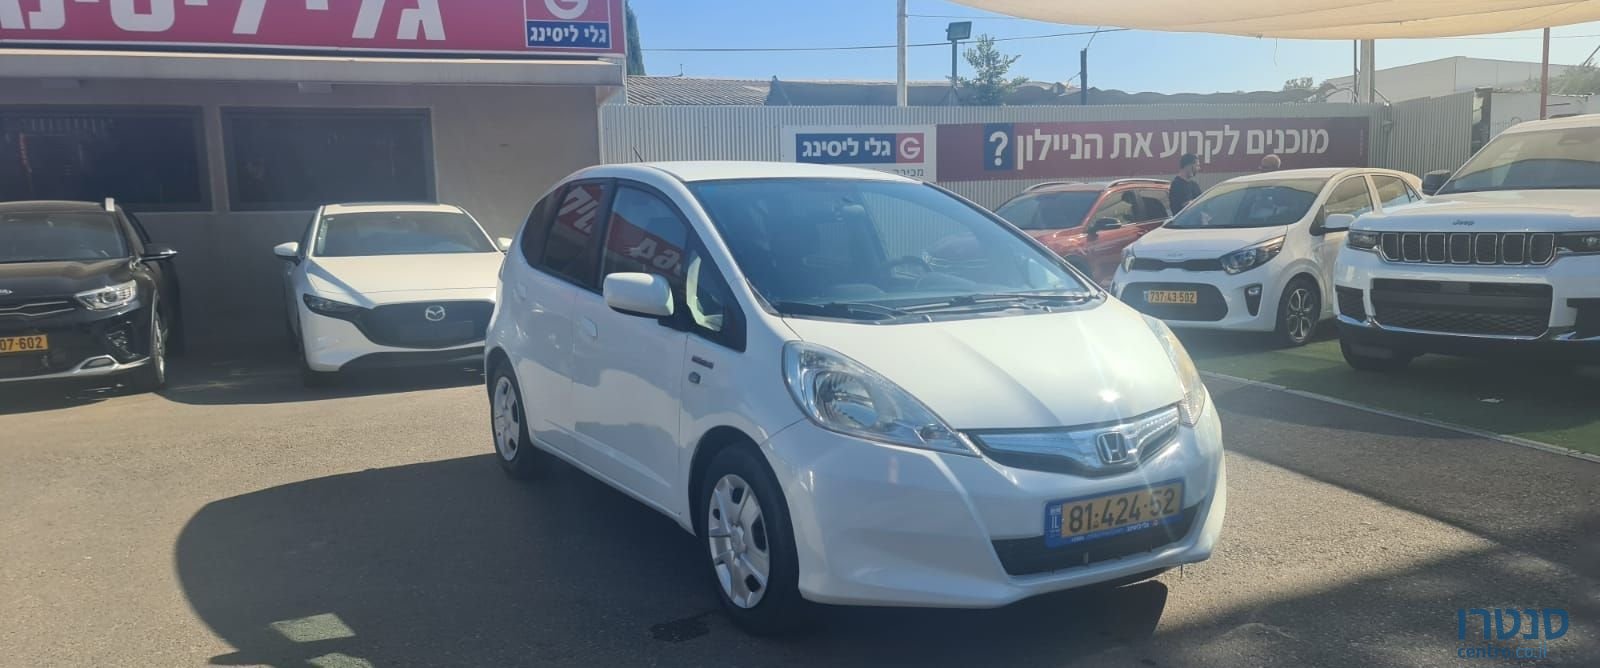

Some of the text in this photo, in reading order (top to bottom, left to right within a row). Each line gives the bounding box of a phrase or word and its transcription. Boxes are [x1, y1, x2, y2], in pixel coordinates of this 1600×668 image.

[529, 25, 607, 43] גלי ליסינג
[802, 137, 859, 157] ליסינג
[864, 137, 891, 157] גלי
[1017, 128, 1103, 170] הניילון
[1110, 132, 1153, 159] את
[1159, 124, 1241, 165] לקרוע
[1246, 128, 1330, 155] מוכנים
